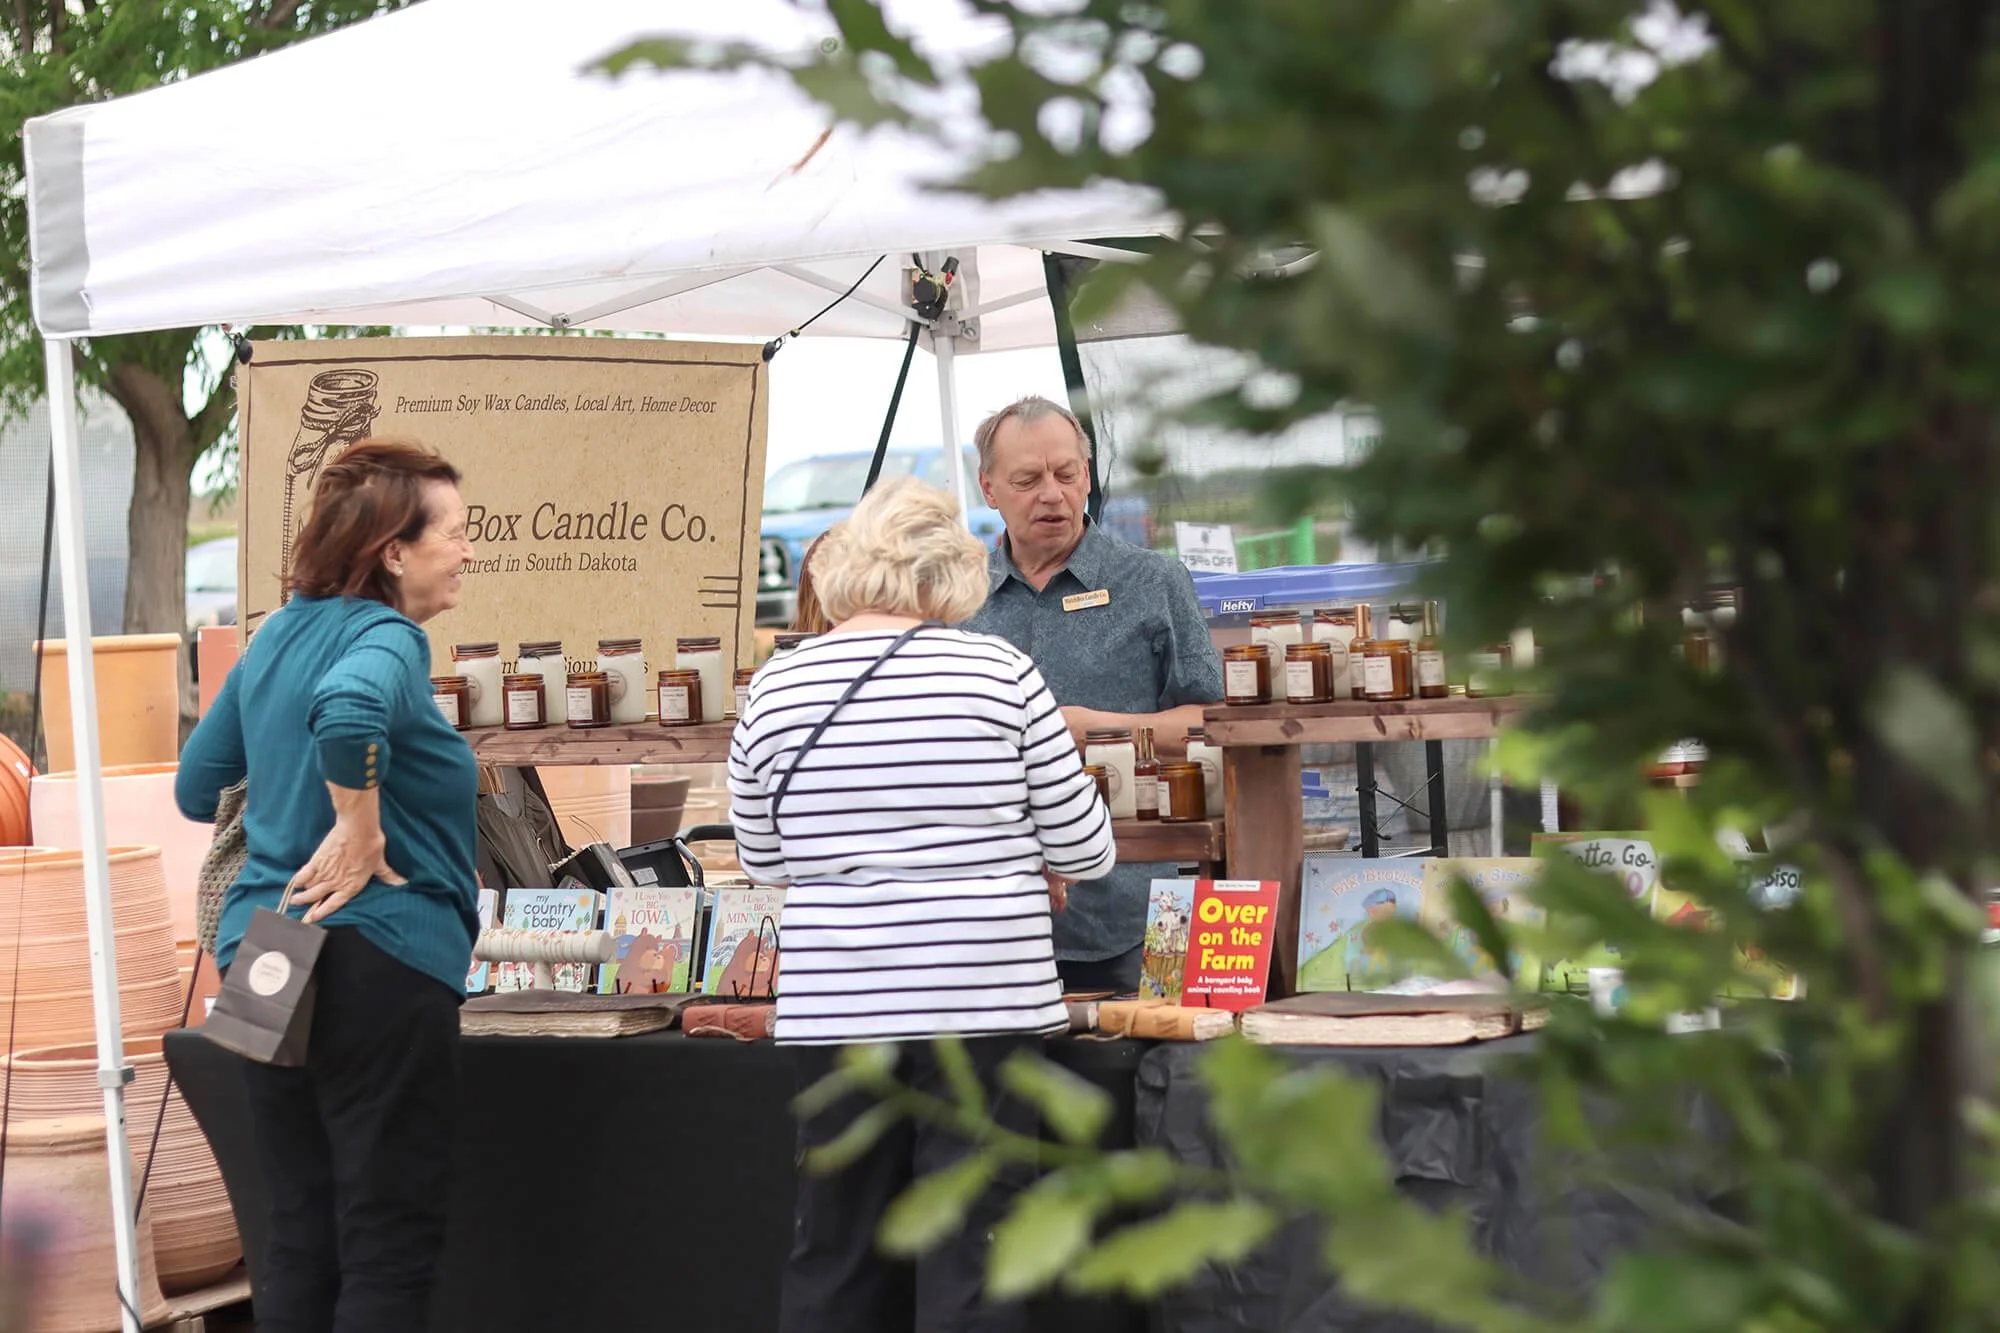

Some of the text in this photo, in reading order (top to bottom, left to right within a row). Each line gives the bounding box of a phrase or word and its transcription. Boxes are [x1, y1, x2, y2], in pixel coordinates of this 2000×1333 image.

[394, 394, 716, 415] Premium Soy Wax Candles, Local Art, Home Decor
[531, 501, 648, 541] Candle
[660, 504, 716, 543] Co.
[460, 552, 637, 575] oured in South Dakota
[1223, 600, 1254, 612] Hefty
[1575, 842, 1616, 868] otta
[536, 895, 549, 905] my
[523, 903, 576, 917] country
[631, 909, 670, 925] IOWA
[1199, 897, 1269, 924] Over
[531, 916, 565, 929] baby
[1199, 927, 1262, 946] on the
[1200, 949, 1254, 971] Farm
[1205, 976, 1236, 986] barnyard
[1237, 976, 1253, 985] baby
[1213, 986, 1242, 996] counting
